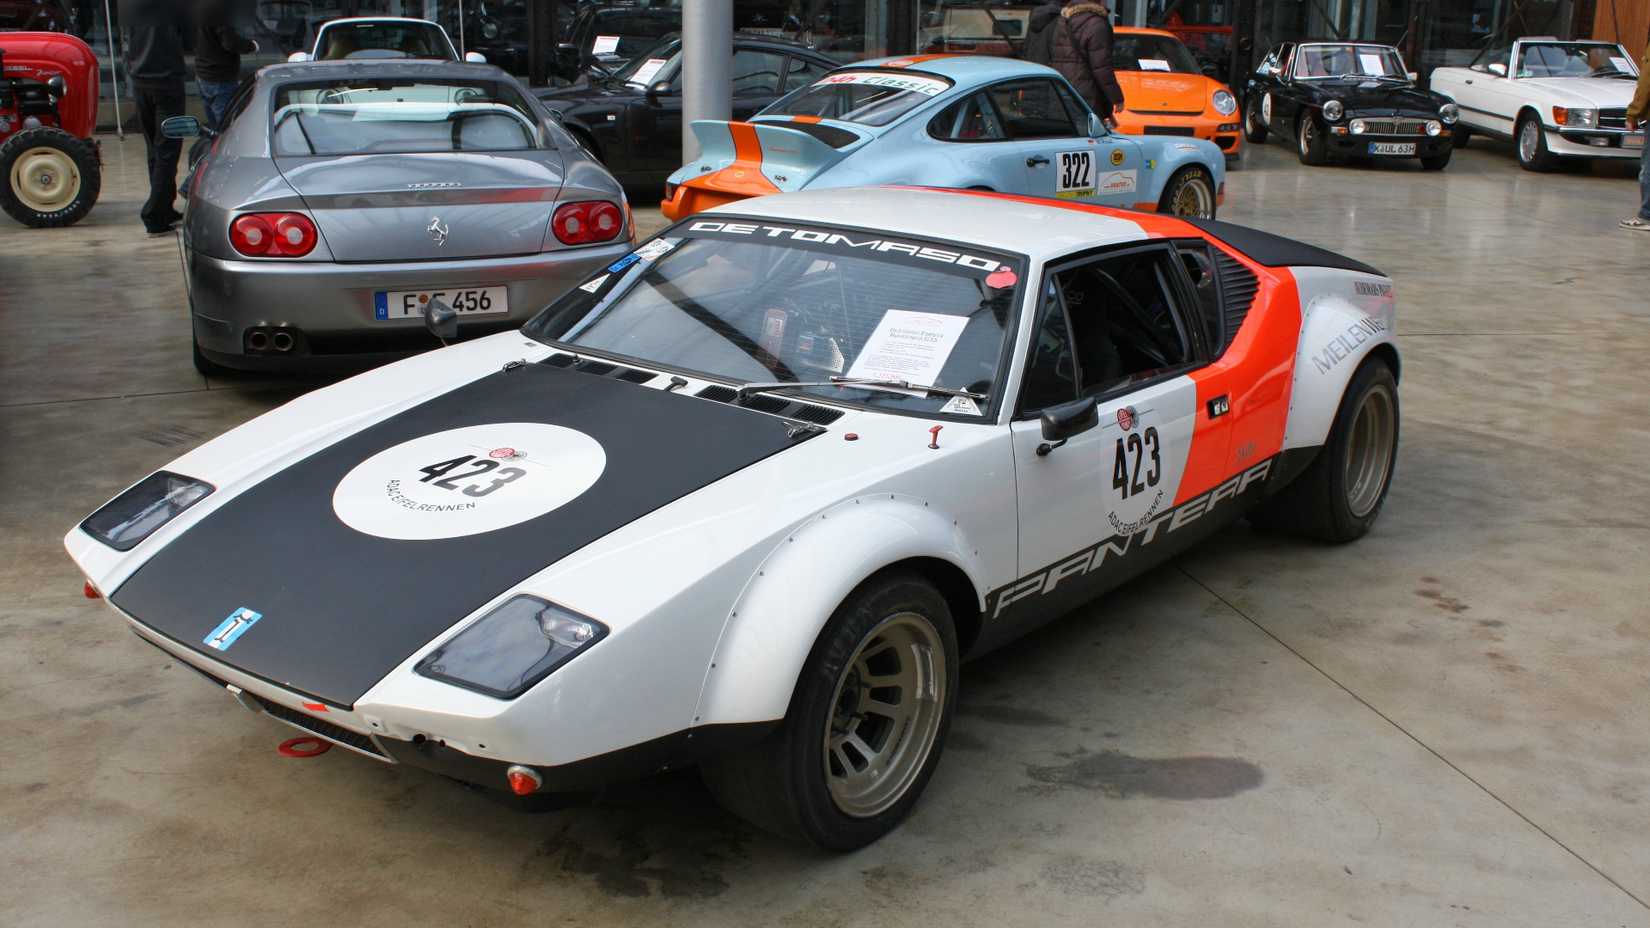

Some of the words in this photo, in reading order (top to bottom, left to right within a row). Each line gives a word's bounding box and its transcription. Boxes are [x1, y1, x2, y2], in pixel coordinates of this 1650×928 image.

[1062, 152, 1091, 189] 322
[403, 294, 417, 315] F
[452, 290, 491, 312] 456
[418, 454, 527, 498] 423
[1112, 426, 1160, 500] 423
[993, 459, 1272, 620] PANTERA
